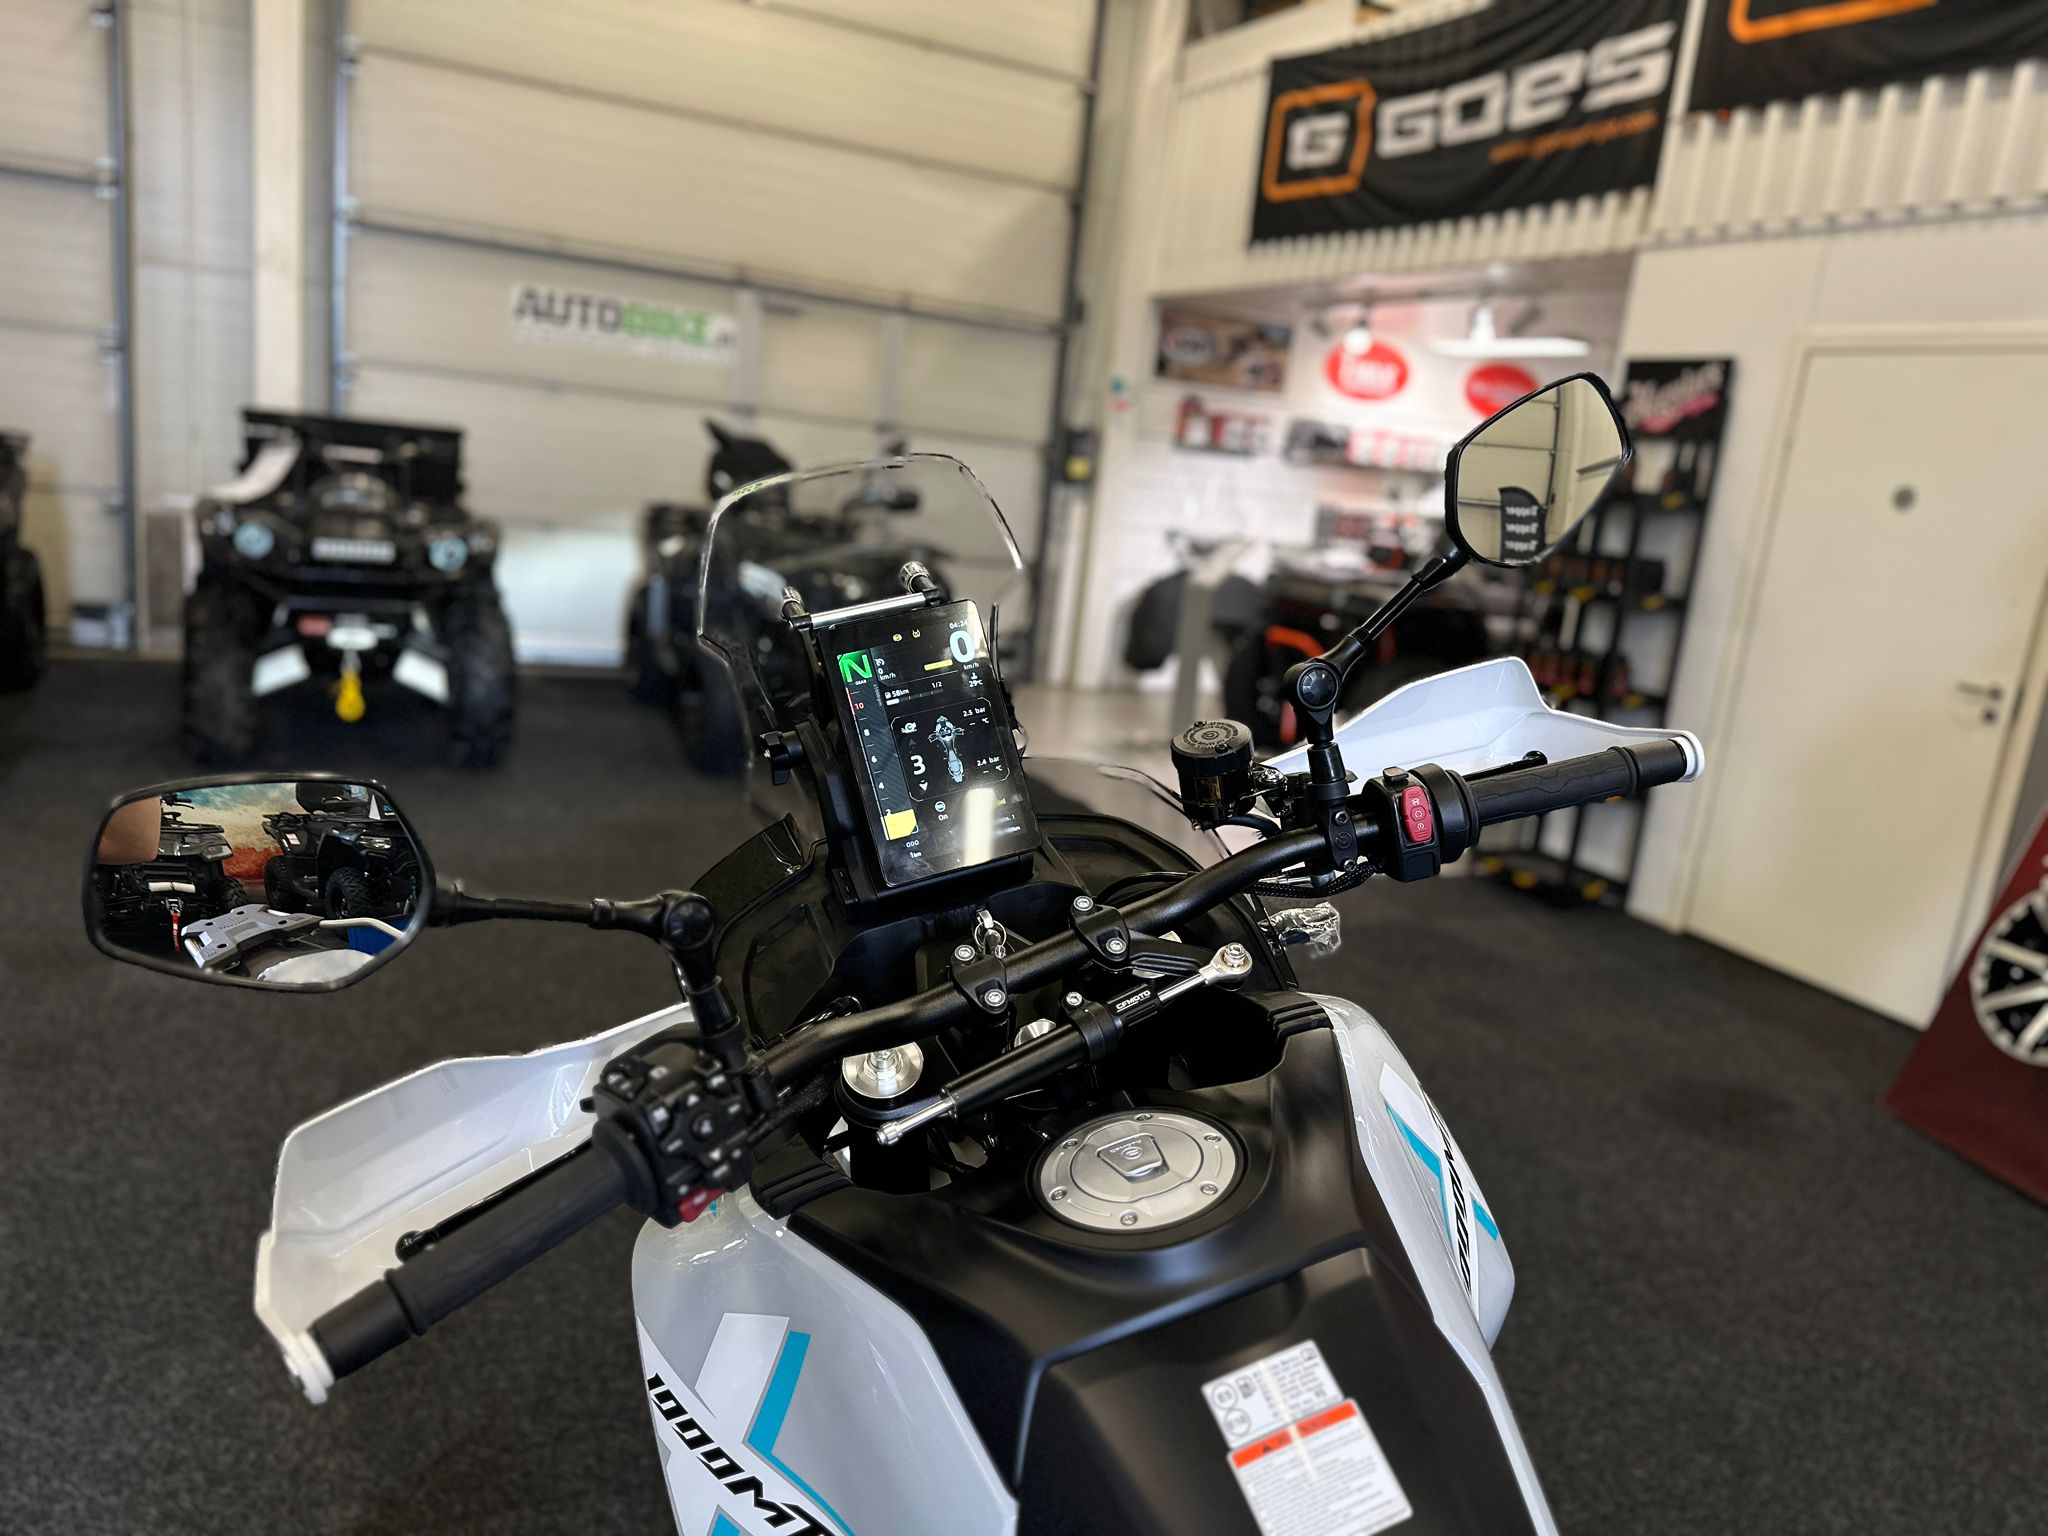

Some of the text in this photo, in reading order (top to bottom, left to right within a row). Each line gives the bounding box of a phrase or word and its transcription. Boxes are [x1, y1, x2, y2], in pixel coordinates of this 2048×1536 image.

[950, 630, 975, 663] 0
[840, 654, 873, 683] N
[963, 662, 980, 670] km/h
[880, 672, 897, 681] km/h
[931, 681, 943, 689] 1/2
[854, 702, 865, 710] 10
[975, 706, 986, 714] bar
[863, 728, 871, 737] 8
[871, 755, 878, 763] 6
[988, 756, 1000, 764] bar
[910, 754, 926, 776] 3
[878, 781, 885, 789] 4
[1115, 989, 1151, 1012] CFMOTO
